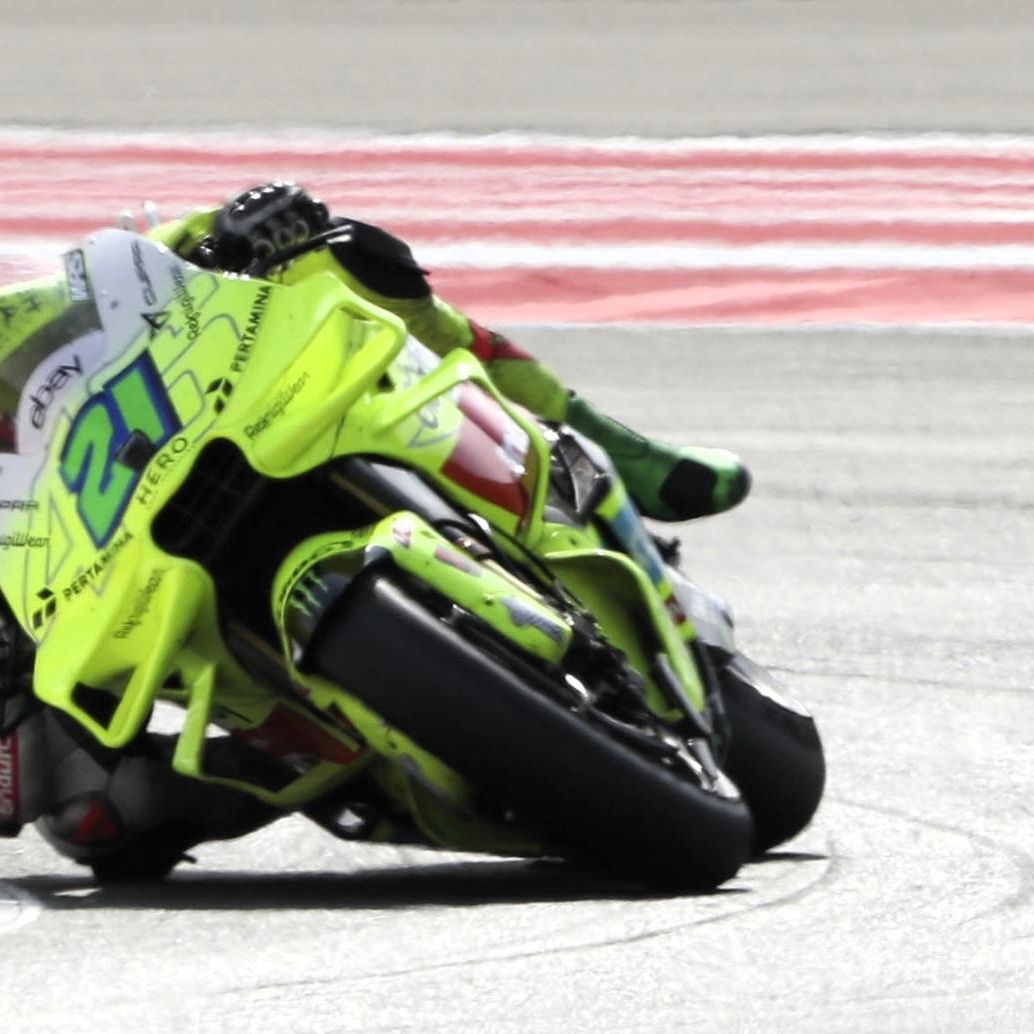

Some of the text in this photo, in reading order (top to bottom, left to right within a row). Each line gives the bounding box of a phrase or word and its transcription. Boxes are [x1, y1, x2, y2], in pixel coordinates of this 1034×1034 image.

[230, 285, 272, 373] PERTAMINA
[31, 355, 83, 430] ebay
[60, 347, 183, 546] 21
[136, 437, 188, 505] HERO
[62, 531, 133, 602] PERTAMINA
